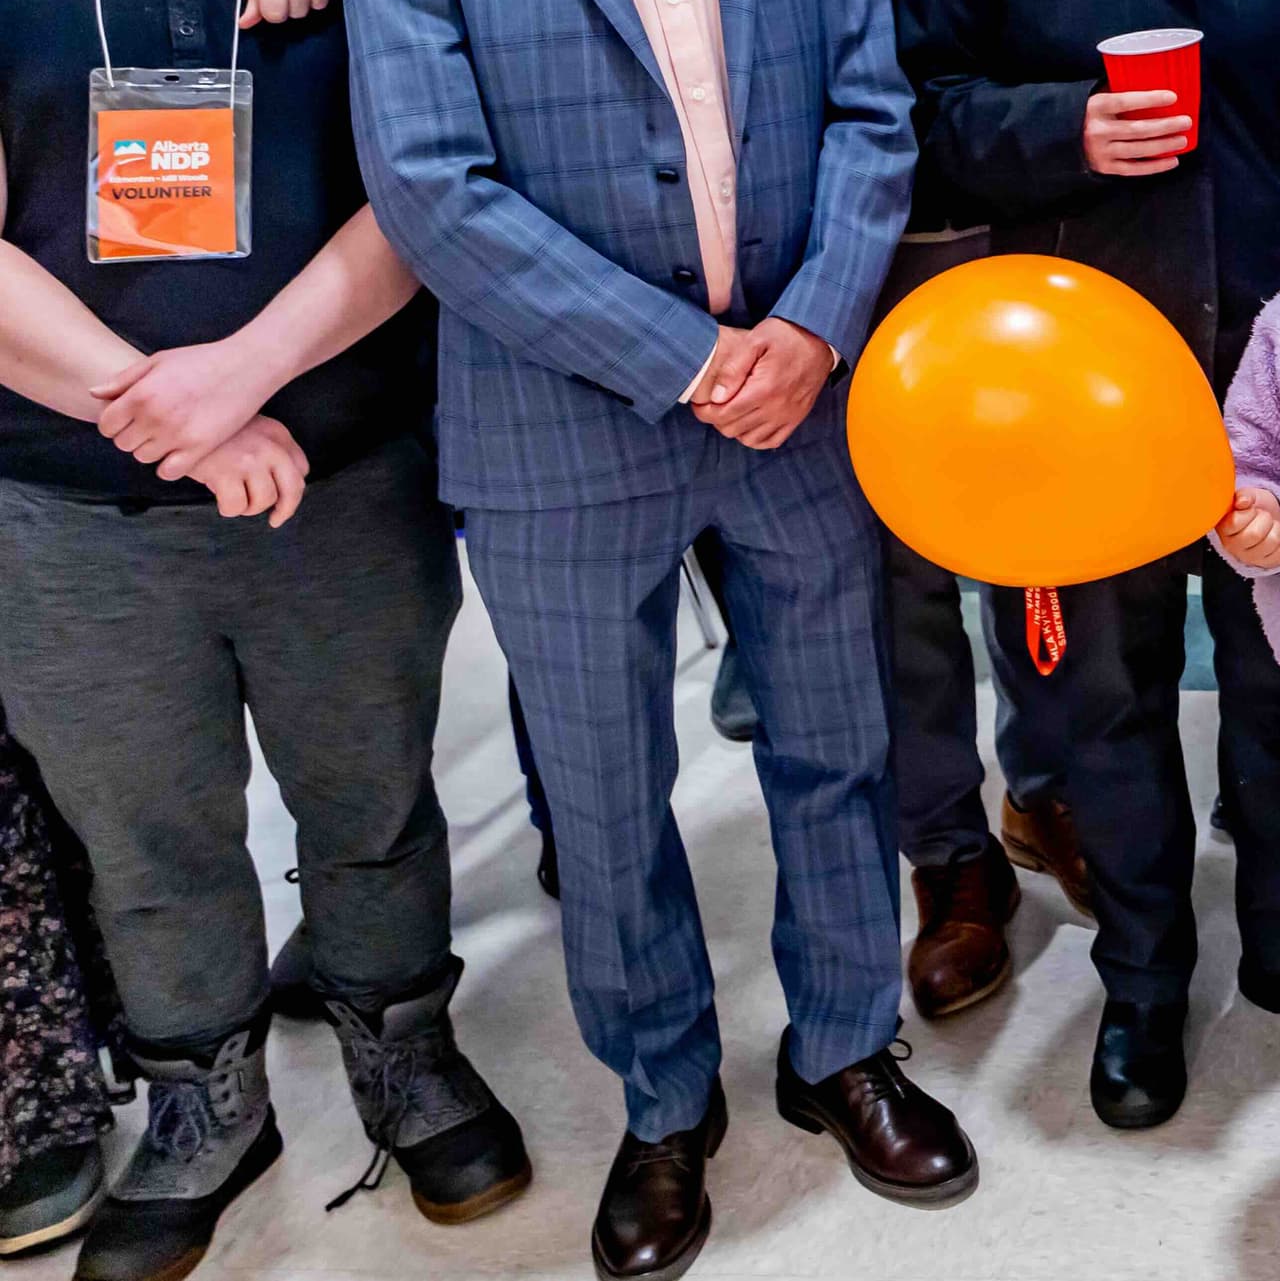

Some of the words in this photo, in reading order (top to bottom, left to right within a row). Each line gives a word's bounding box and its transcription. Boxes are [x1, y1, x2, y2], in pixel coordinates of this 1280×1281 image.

[151, 140, 209, 153] Alberta
[150, 152, 210, 170] NDP
[111, 186, 212, 200] VOLUNTEER
